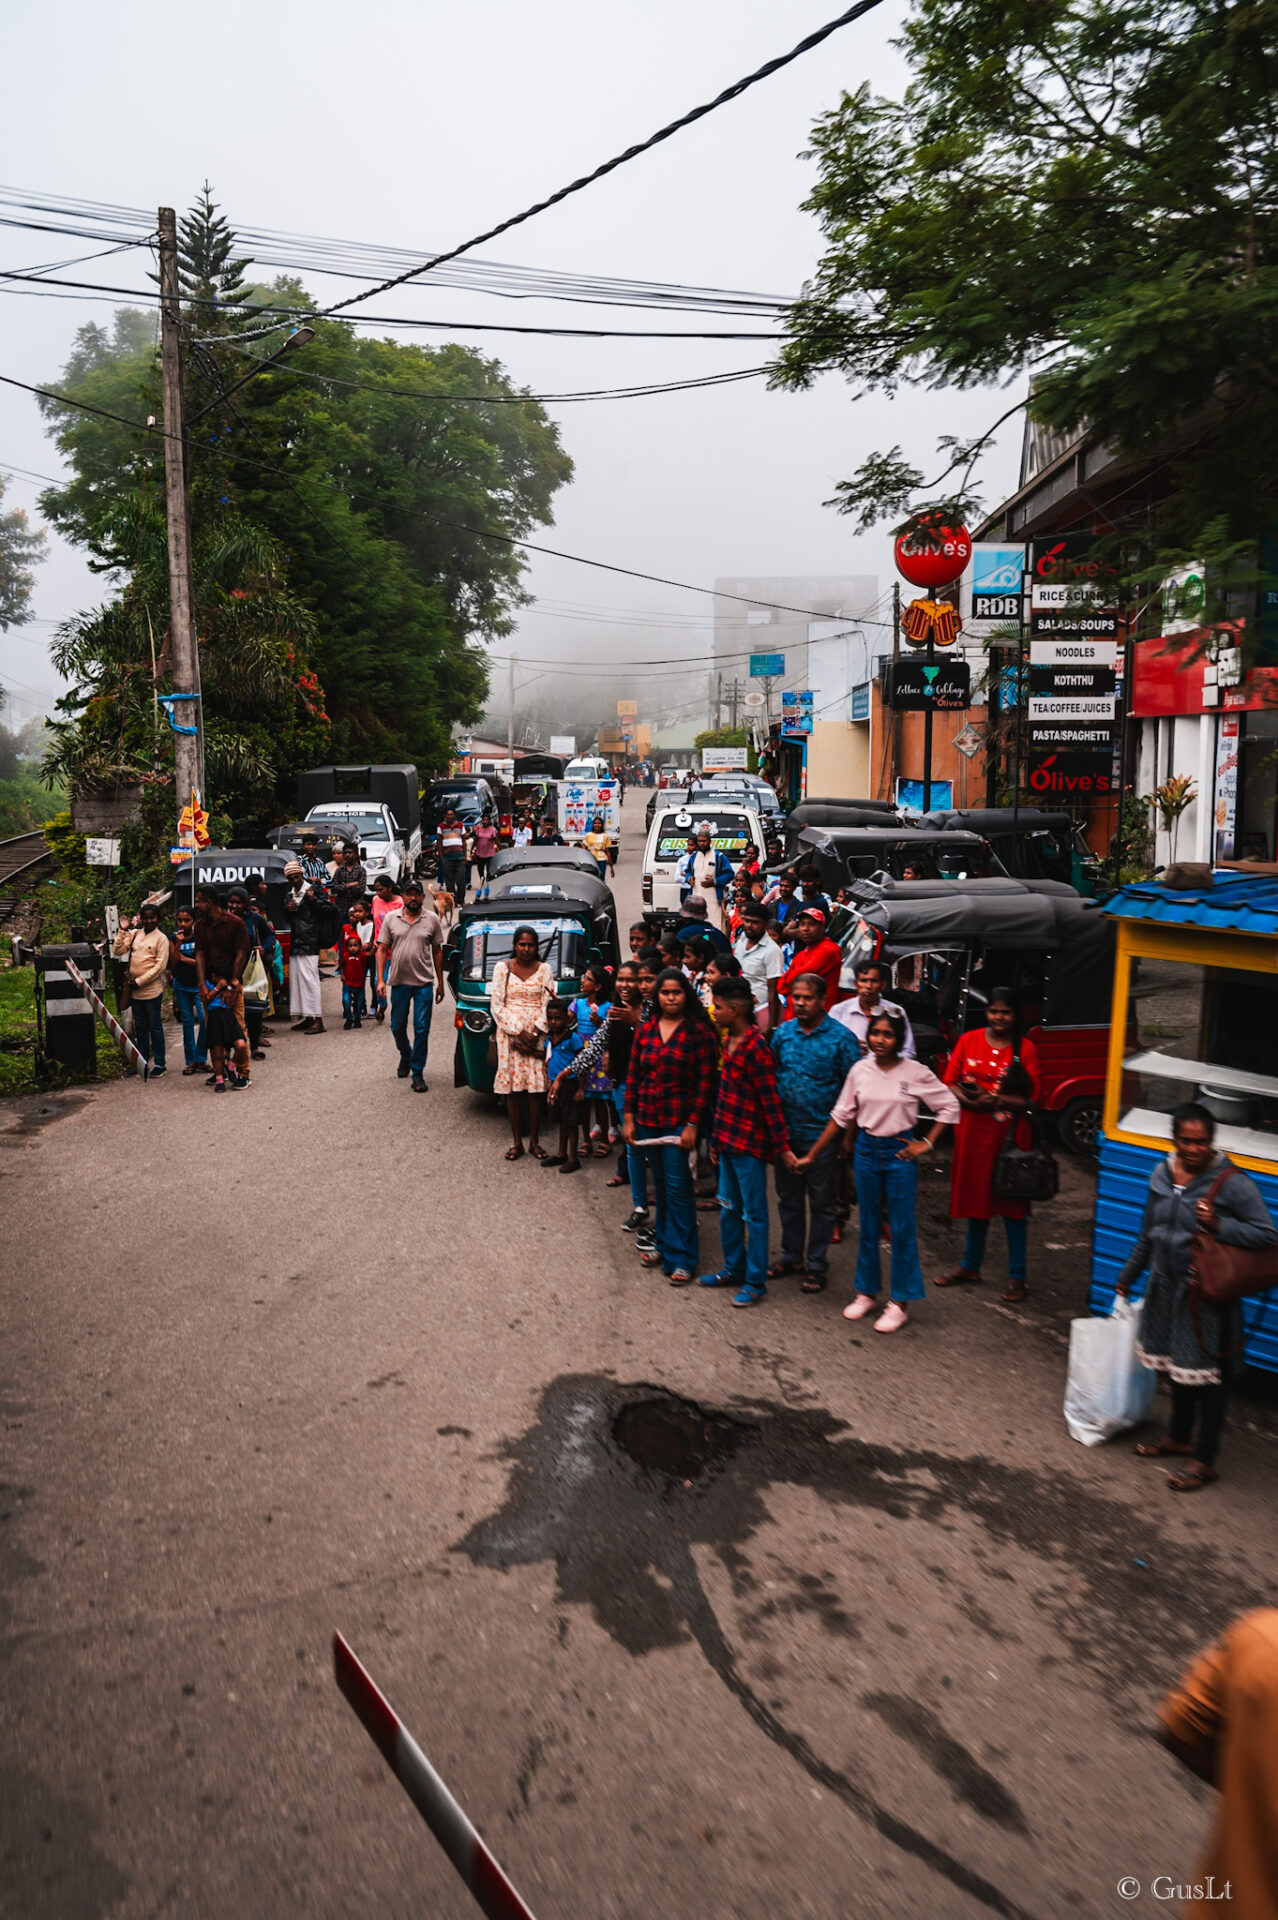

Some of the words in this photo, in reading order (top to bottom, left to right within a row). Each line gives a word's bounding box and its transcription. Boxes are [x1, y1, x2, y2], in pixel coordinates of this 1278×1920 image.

[1039, 591, 1109, 601] RICE&CURR
[976, 598, 1018, 616] RDB
[1037, 619, 1115, 630] SALADS/SOUPS
[1055, 647, 1095, 657] NOODLES
[1053, 675, 1094, 686] KOTHTHU
[1032, 703, 1111, 713] TEA/COFFEE/JUICES
[1032, 730, 1110, 741] PASTA/SPAGHETTI
[1030, 757, 1109, 791] Olive's
[198, 867, 265, 883] NADUN
